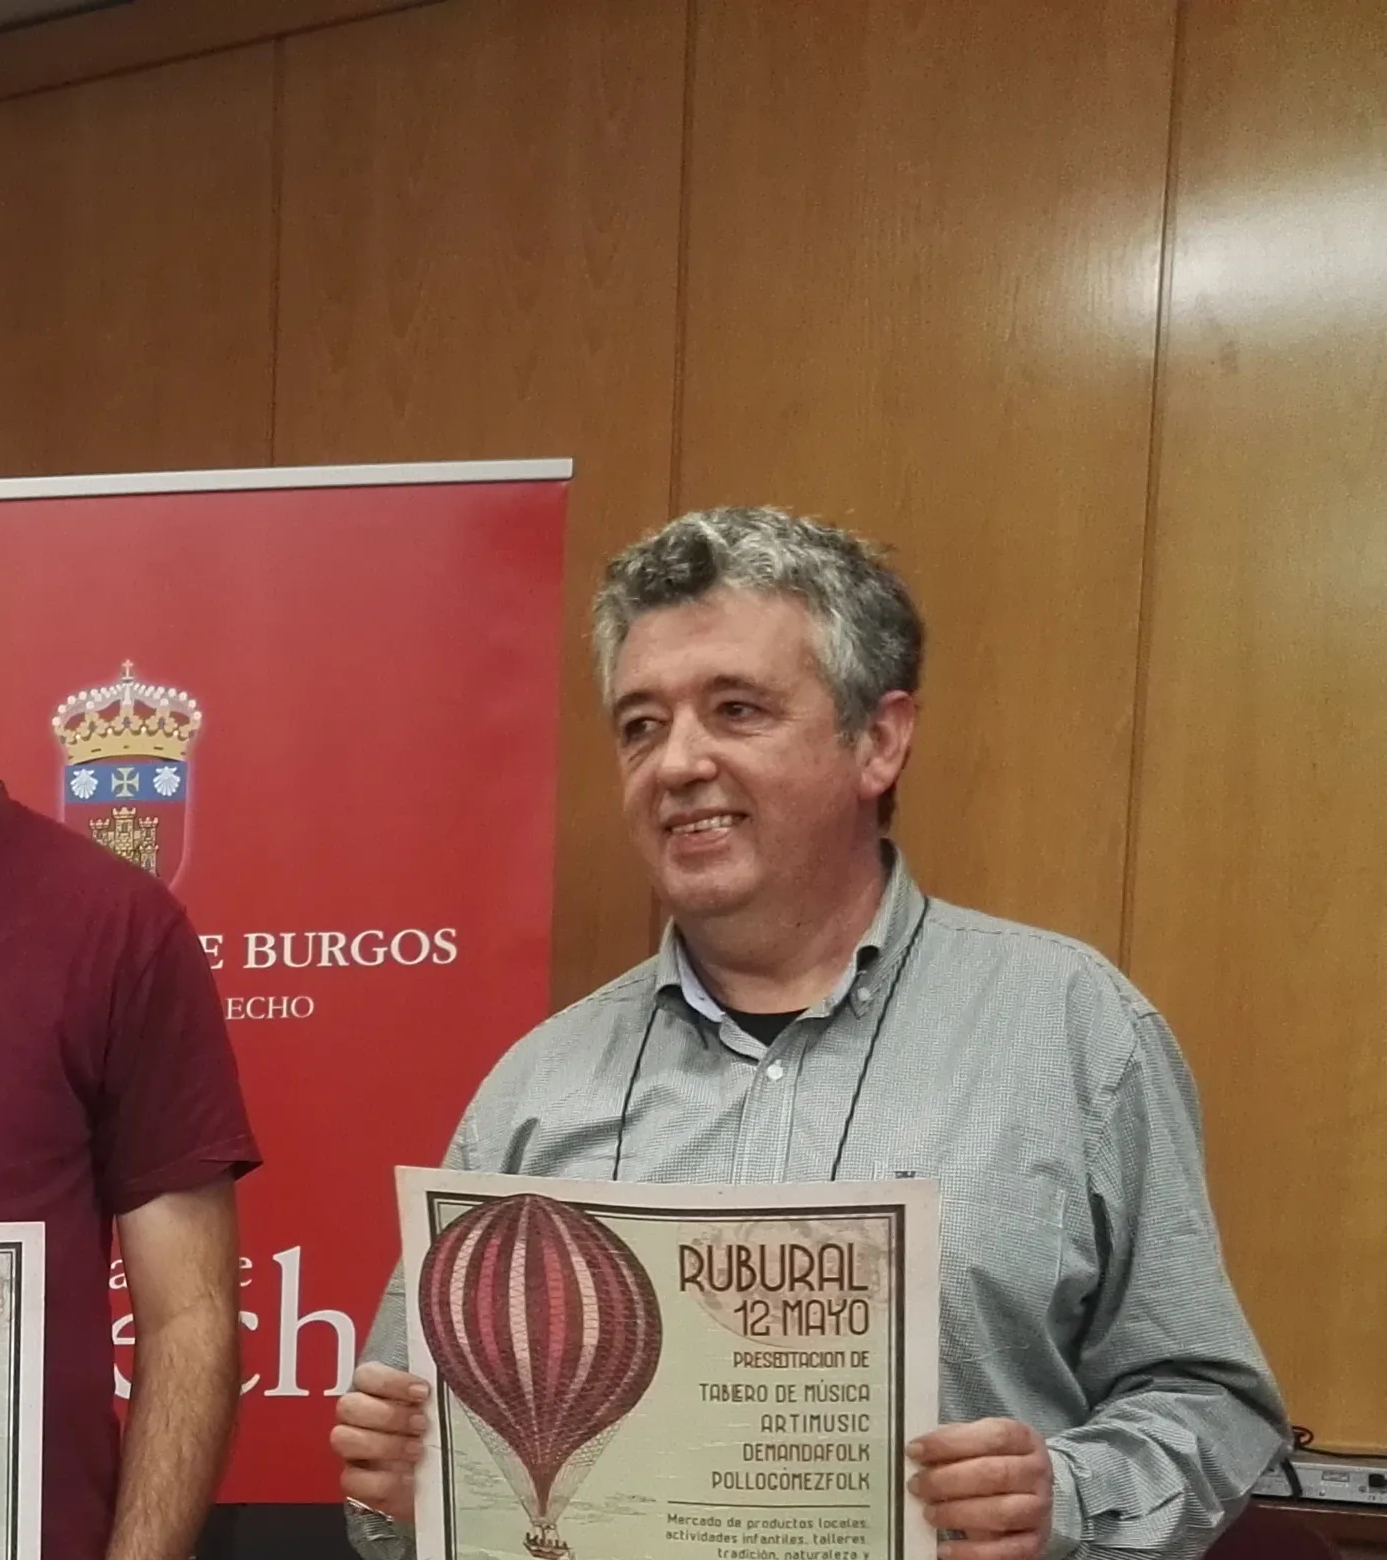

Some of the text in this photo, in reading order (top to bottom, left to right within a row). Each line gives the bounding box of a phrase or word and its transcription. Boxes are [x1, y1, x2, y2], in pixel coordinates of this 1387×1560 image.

[200, 928, 458, 970] E BURGOS
[226, 996, 315, 1021] ECHO
[678, 1242, 868, 1290] RUBURAL
[734, 1299, 869, 1335] 12 MAYO
[850, 1351, 870, 1367] DE
[776, 1384, 796, 1402] DE
[762, 1413, 870, 1432] ARTIMUSIC
[743, 1443, 869, 1462] DEMANDAFOLK
